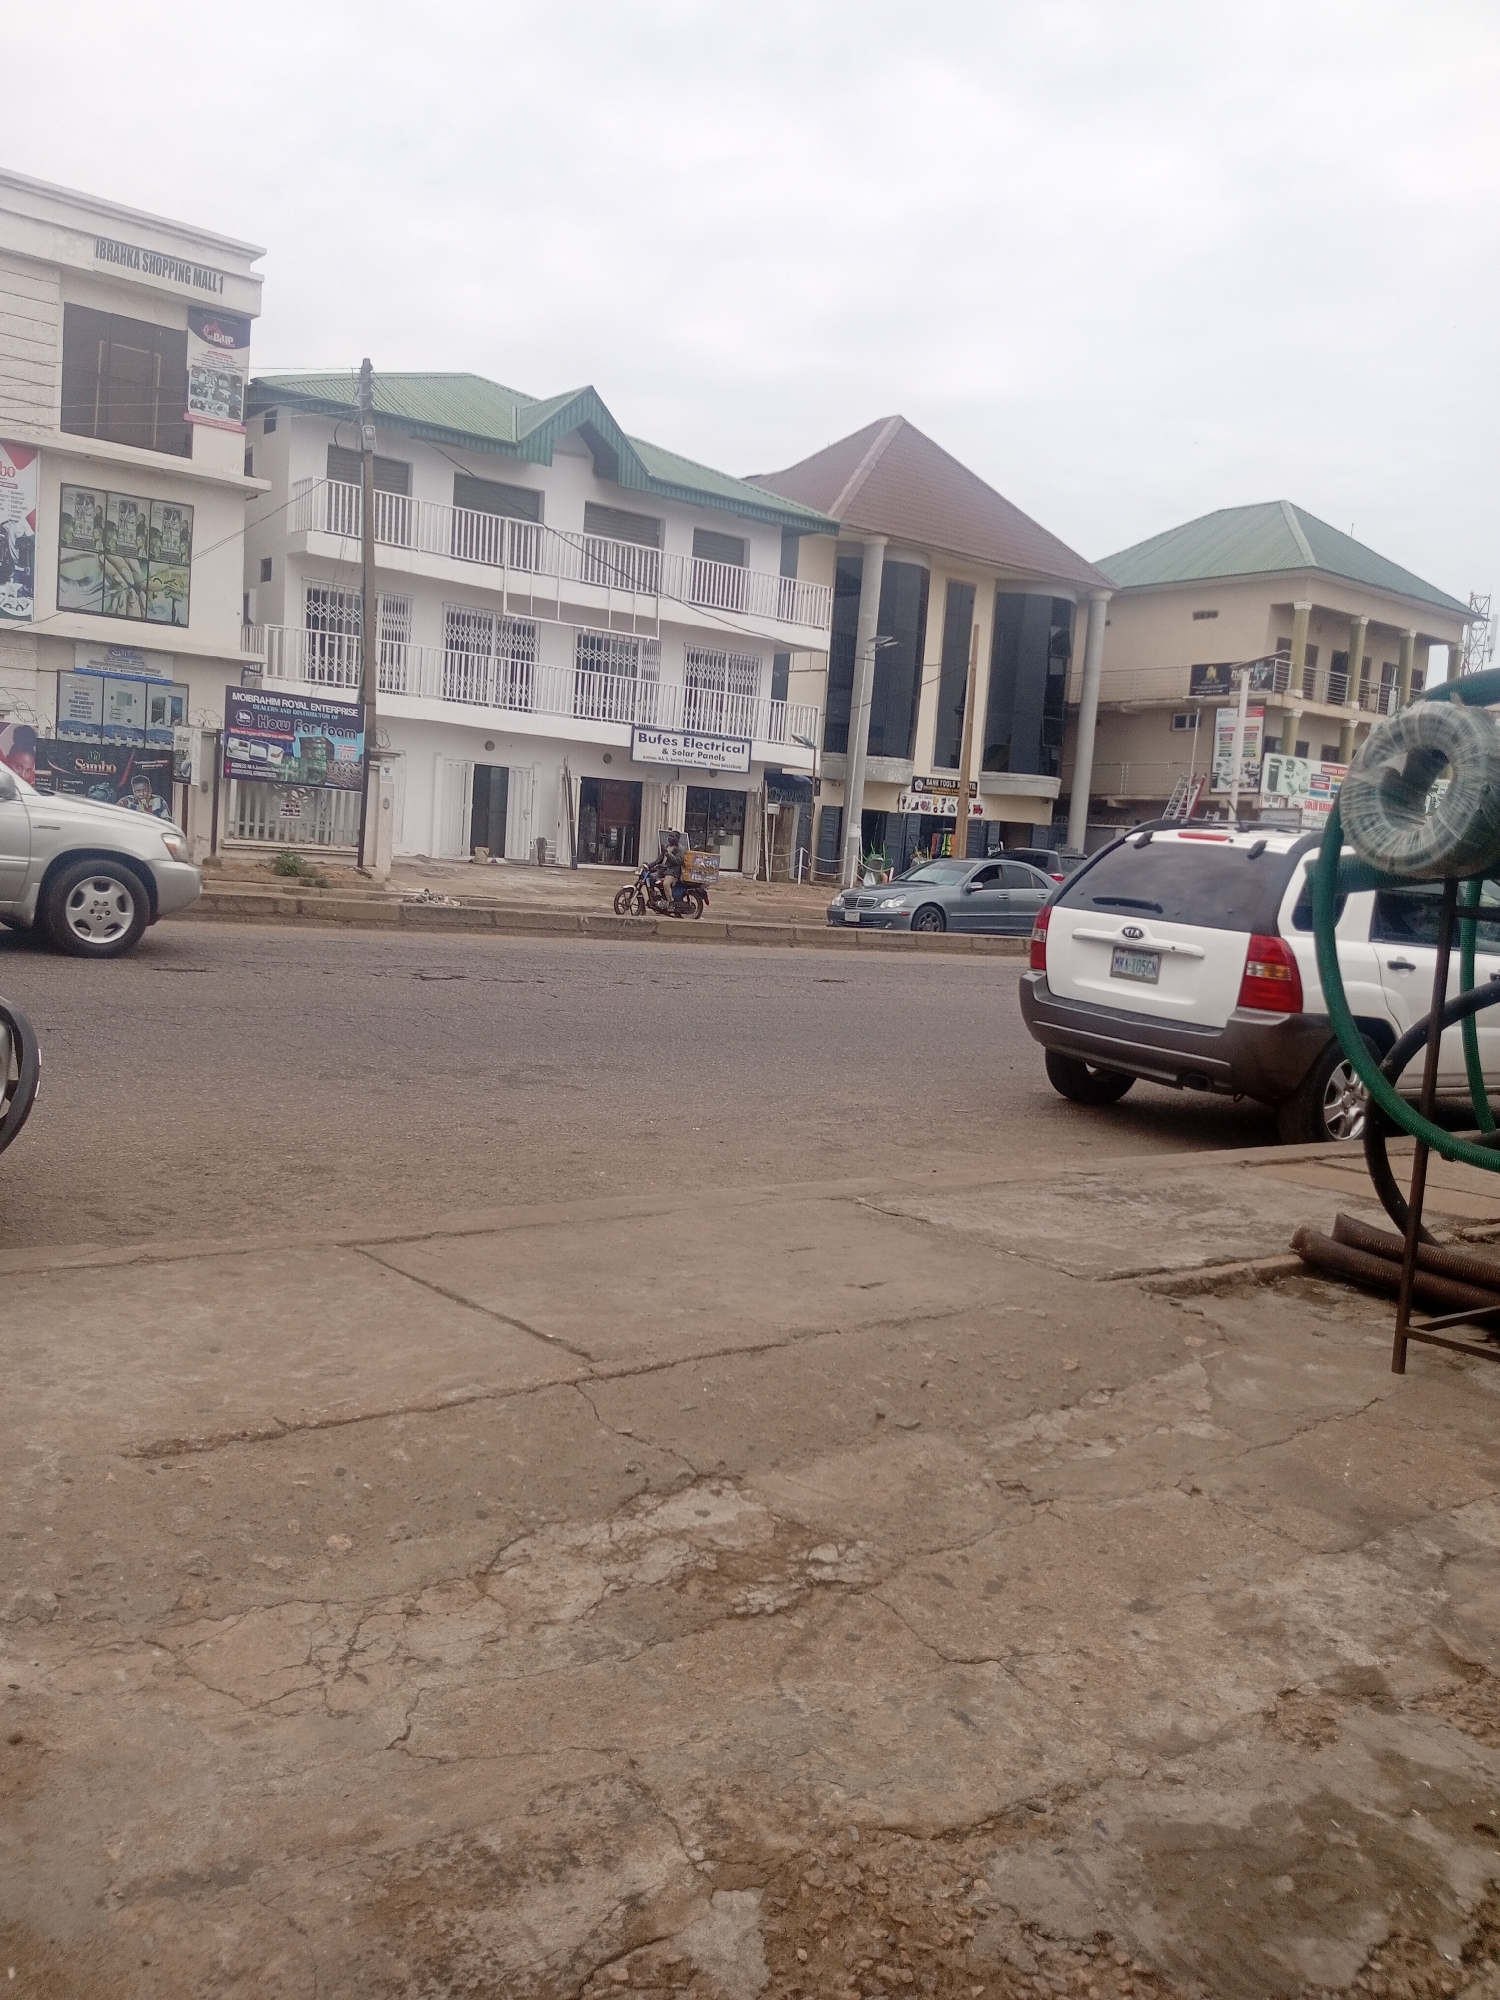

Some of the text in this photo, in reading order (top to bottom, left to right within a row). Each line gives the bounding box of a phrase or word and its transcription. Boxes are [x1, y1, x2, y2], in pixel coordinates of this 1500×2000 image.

[96, 239, 224, 294] IBRAHKA SHOPPING MALL 1
[232, 692, 359, 718] MOIBRAHIM ROYAL ENTERPRISE
[252, 704, 279, 713] DEALERS
[292, 709, 331, 720] DISTRIBUTOR
[257, 714, 291, 731] How
[638, 732, 745, 754] Bufes Electrical
[671, 748, 695, 758] Solar
[697, 751, 726, 762] Panels
[74, 758, 117, 773] Sambo
[926, 779, 939, 787] BANK
[940, 780, 956, 788] TOOLS
[1304, 800, 1318, 810] SOLID
[1124, 928, 1140, 937] KIA
